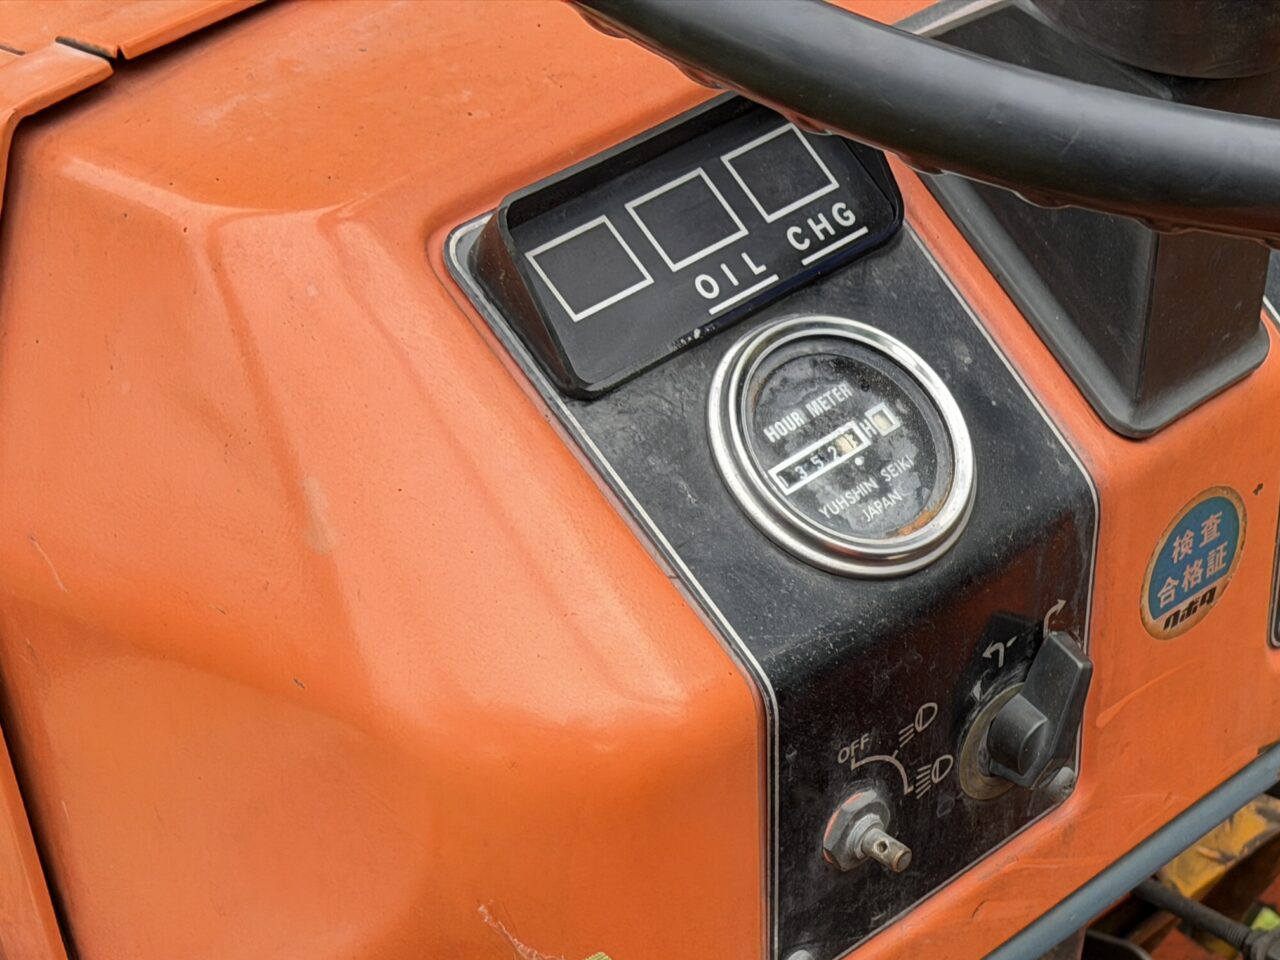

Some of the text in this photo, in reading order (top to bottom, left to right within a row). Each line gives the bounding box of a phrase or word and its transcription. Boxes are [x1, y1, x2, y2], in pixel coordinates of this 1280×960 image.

[786, 202, 856, 250] CHG
[694, 252, 767, 299] OIL
[763, 380, 853, 443] HOUR METER
[818, 454, 915, 519] YUHSHIN SEIKI
[861, 489, 904, 523] JAPAN
[1172, 511, 1222, 564] 検査
[1157, 541, 1229, 609] 合格証
[1162, 587, 1217, 631] クボタ
[837, 733, 869, 764] OFF
